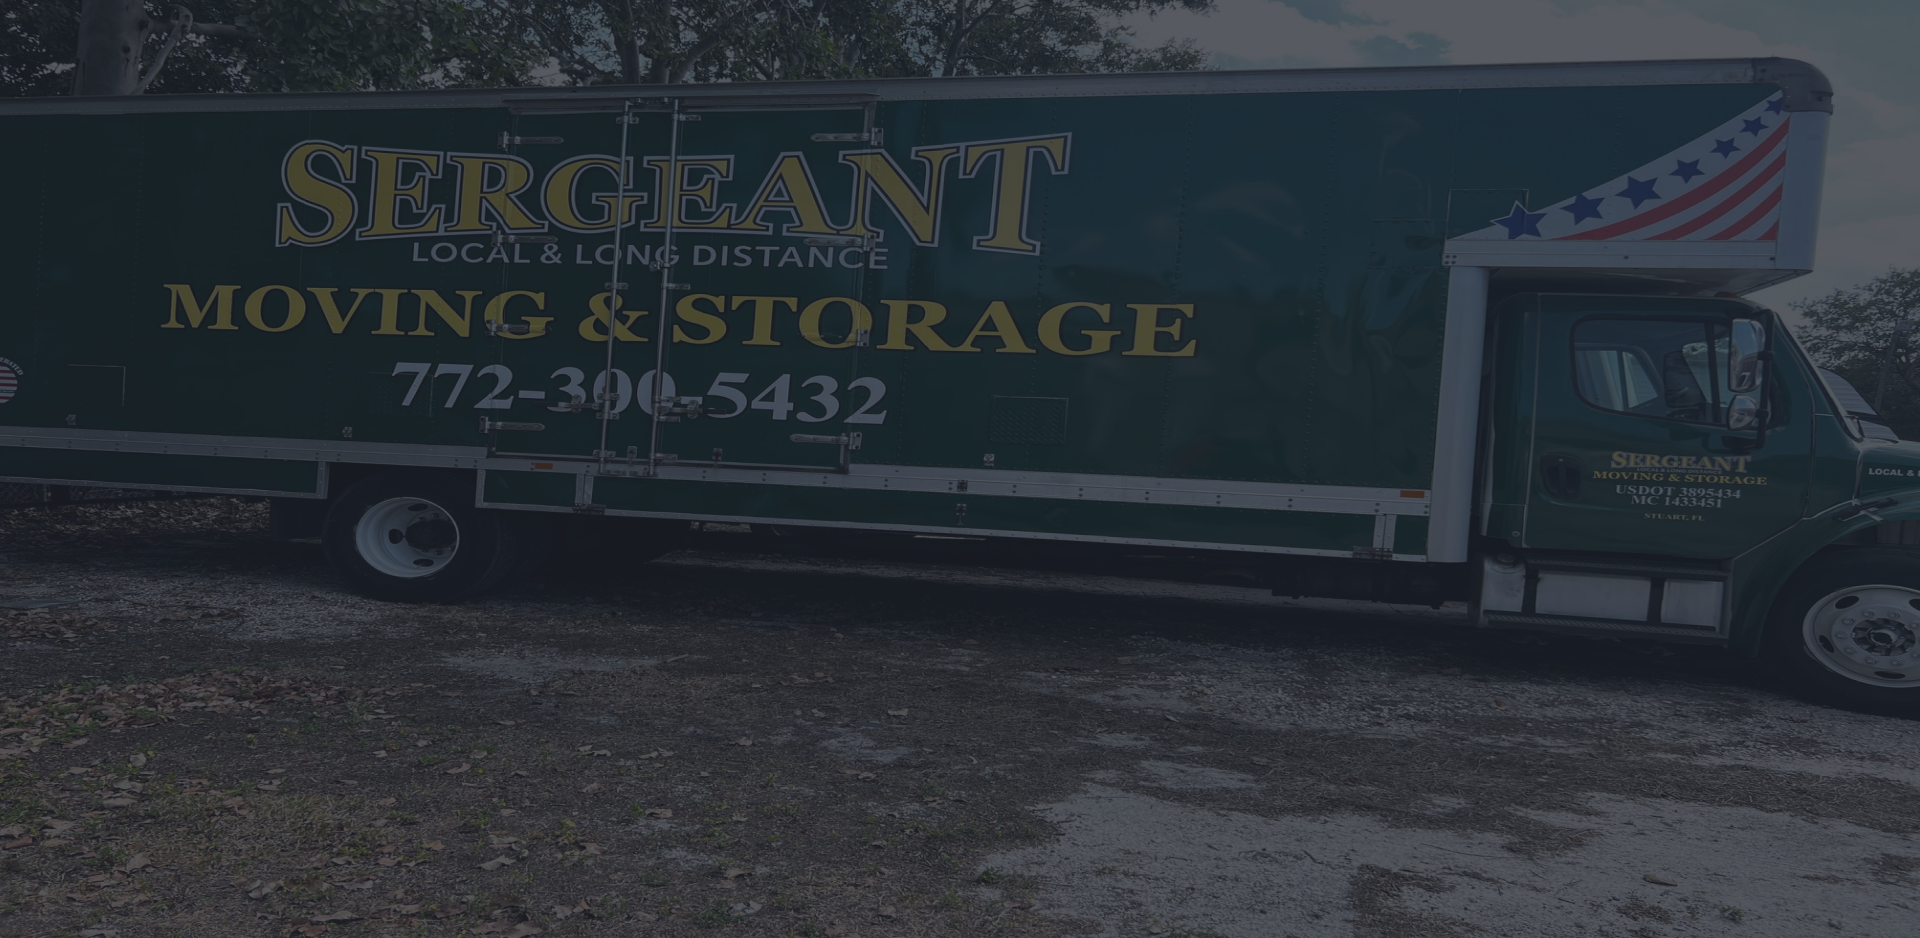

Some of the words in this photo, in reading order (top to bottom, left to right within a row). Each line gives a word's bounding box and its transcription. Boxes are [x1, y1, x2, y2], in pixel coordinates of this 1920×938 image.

[275, 131, 1072, 256] SERGEANT
[411, 241, 531, 264] LOCAL
[539, 243, 562, 264] &
[575, 243, 680, 267] LONG
[691, 245, 889, 270] DISTANCE
[160, 283, 553, 340] MOVING
[577, 291, 651, 343] &
[671, 292, 1197, 358] STORAGE
[391, 361, 888, 426] 772-300-5432
[1611, 451, 1751, 473] SERGEANT
[1868, 468, 1904, 476] LOCAL
[1906, 469, 1915, 477] &
[1593, 471, 1664, 482] MOVING
[1668, 473, 1681, 482] &
[1684, 474, 1767, 485] STORAGE
[1615, 485, 1675, 496] USDOT
[1679, 487, 1741, 499] 3895434
[1631, 495, 1659, 505] MC
[1664, 496, 1722, 508] 1433451
